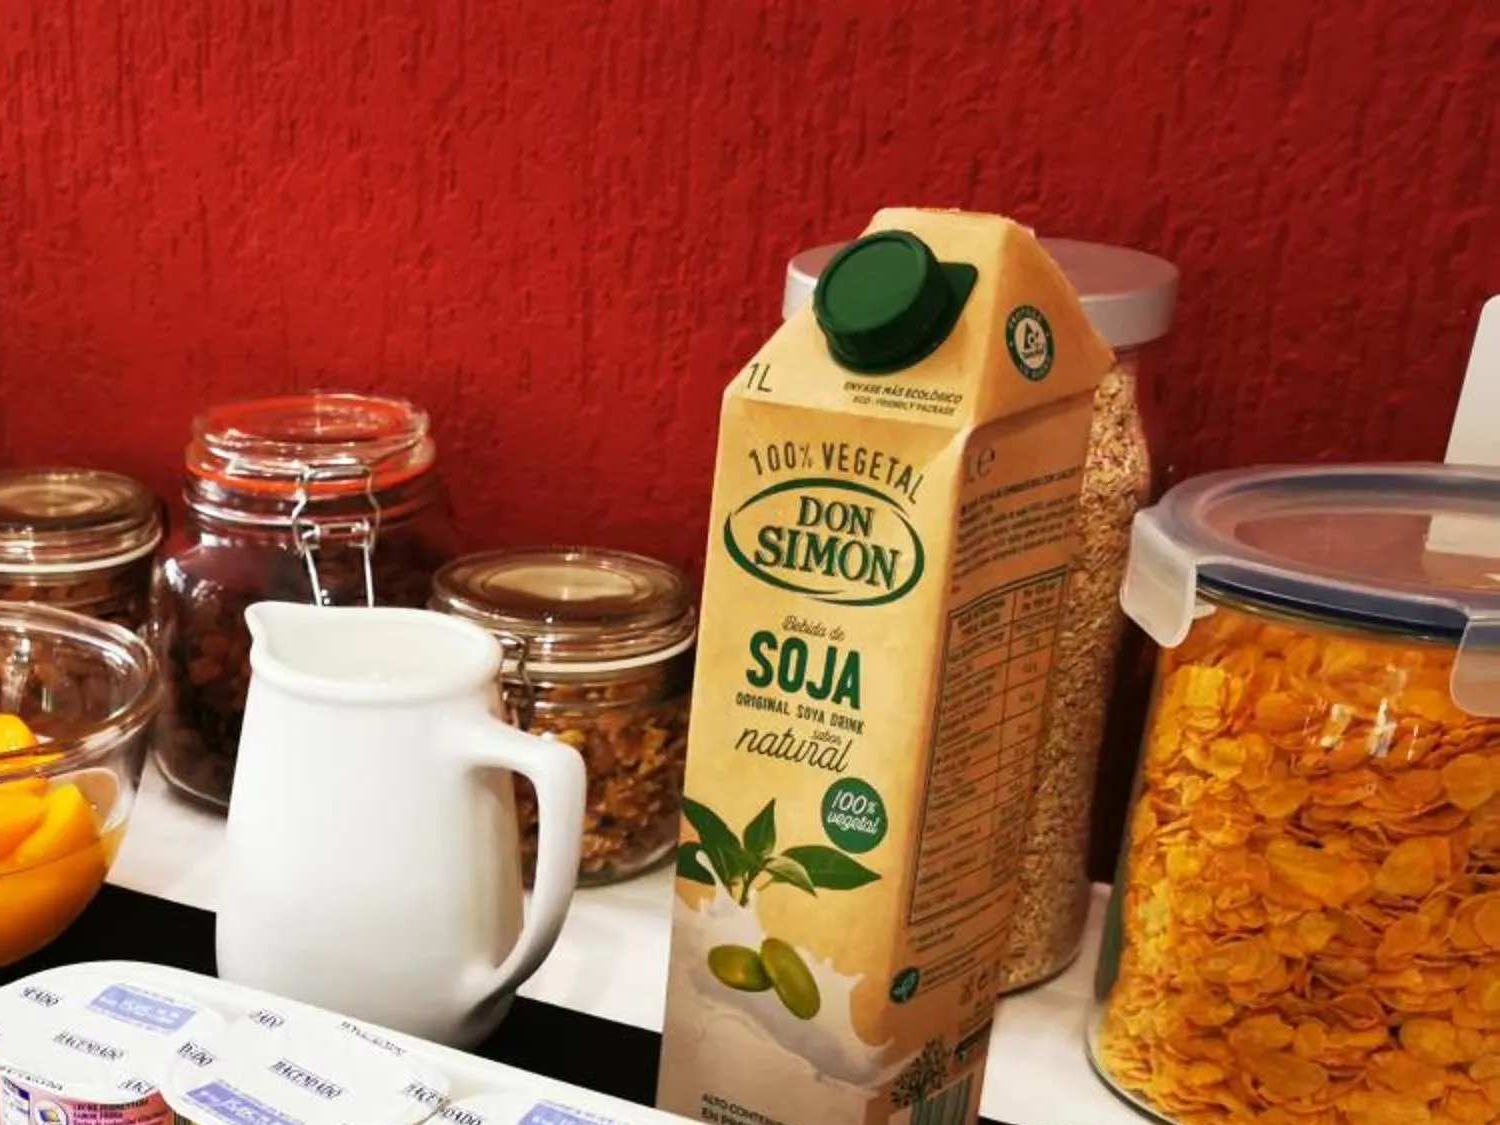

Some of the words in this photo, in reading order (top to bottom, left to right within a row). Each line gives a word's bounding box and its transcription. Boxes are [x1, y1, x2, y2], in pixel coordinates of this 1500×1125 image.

[747, 362, 772, 393] 1L
[843, 381, 882, 395] ENVASE
[883, 384, 904, 397] MÁS
[904, 386, 963, 404] ECOLÓGICO
[748, 441, 813, 476] 100%
[821, 441, 924, 505] VEGETAL
[797, 495, 875, 538] DON
[753, 527, 900, 591] SIMON
[782, 615, 826, 638] Bebida
[829, 624, 845, 642] de
[745, 630, 861, 710] SOJA
[735, 691, 790, 716] ORIGINAL
[797, 704, 825, 725] SOYA
[830, 713, 865, 735] DRINK
[734, 727, 853, 773] natural
[831, 789, 877, 815] 100%
[827, 811, 880, 835] vegetal
[702, 1093, 728, 1109] ALTO
